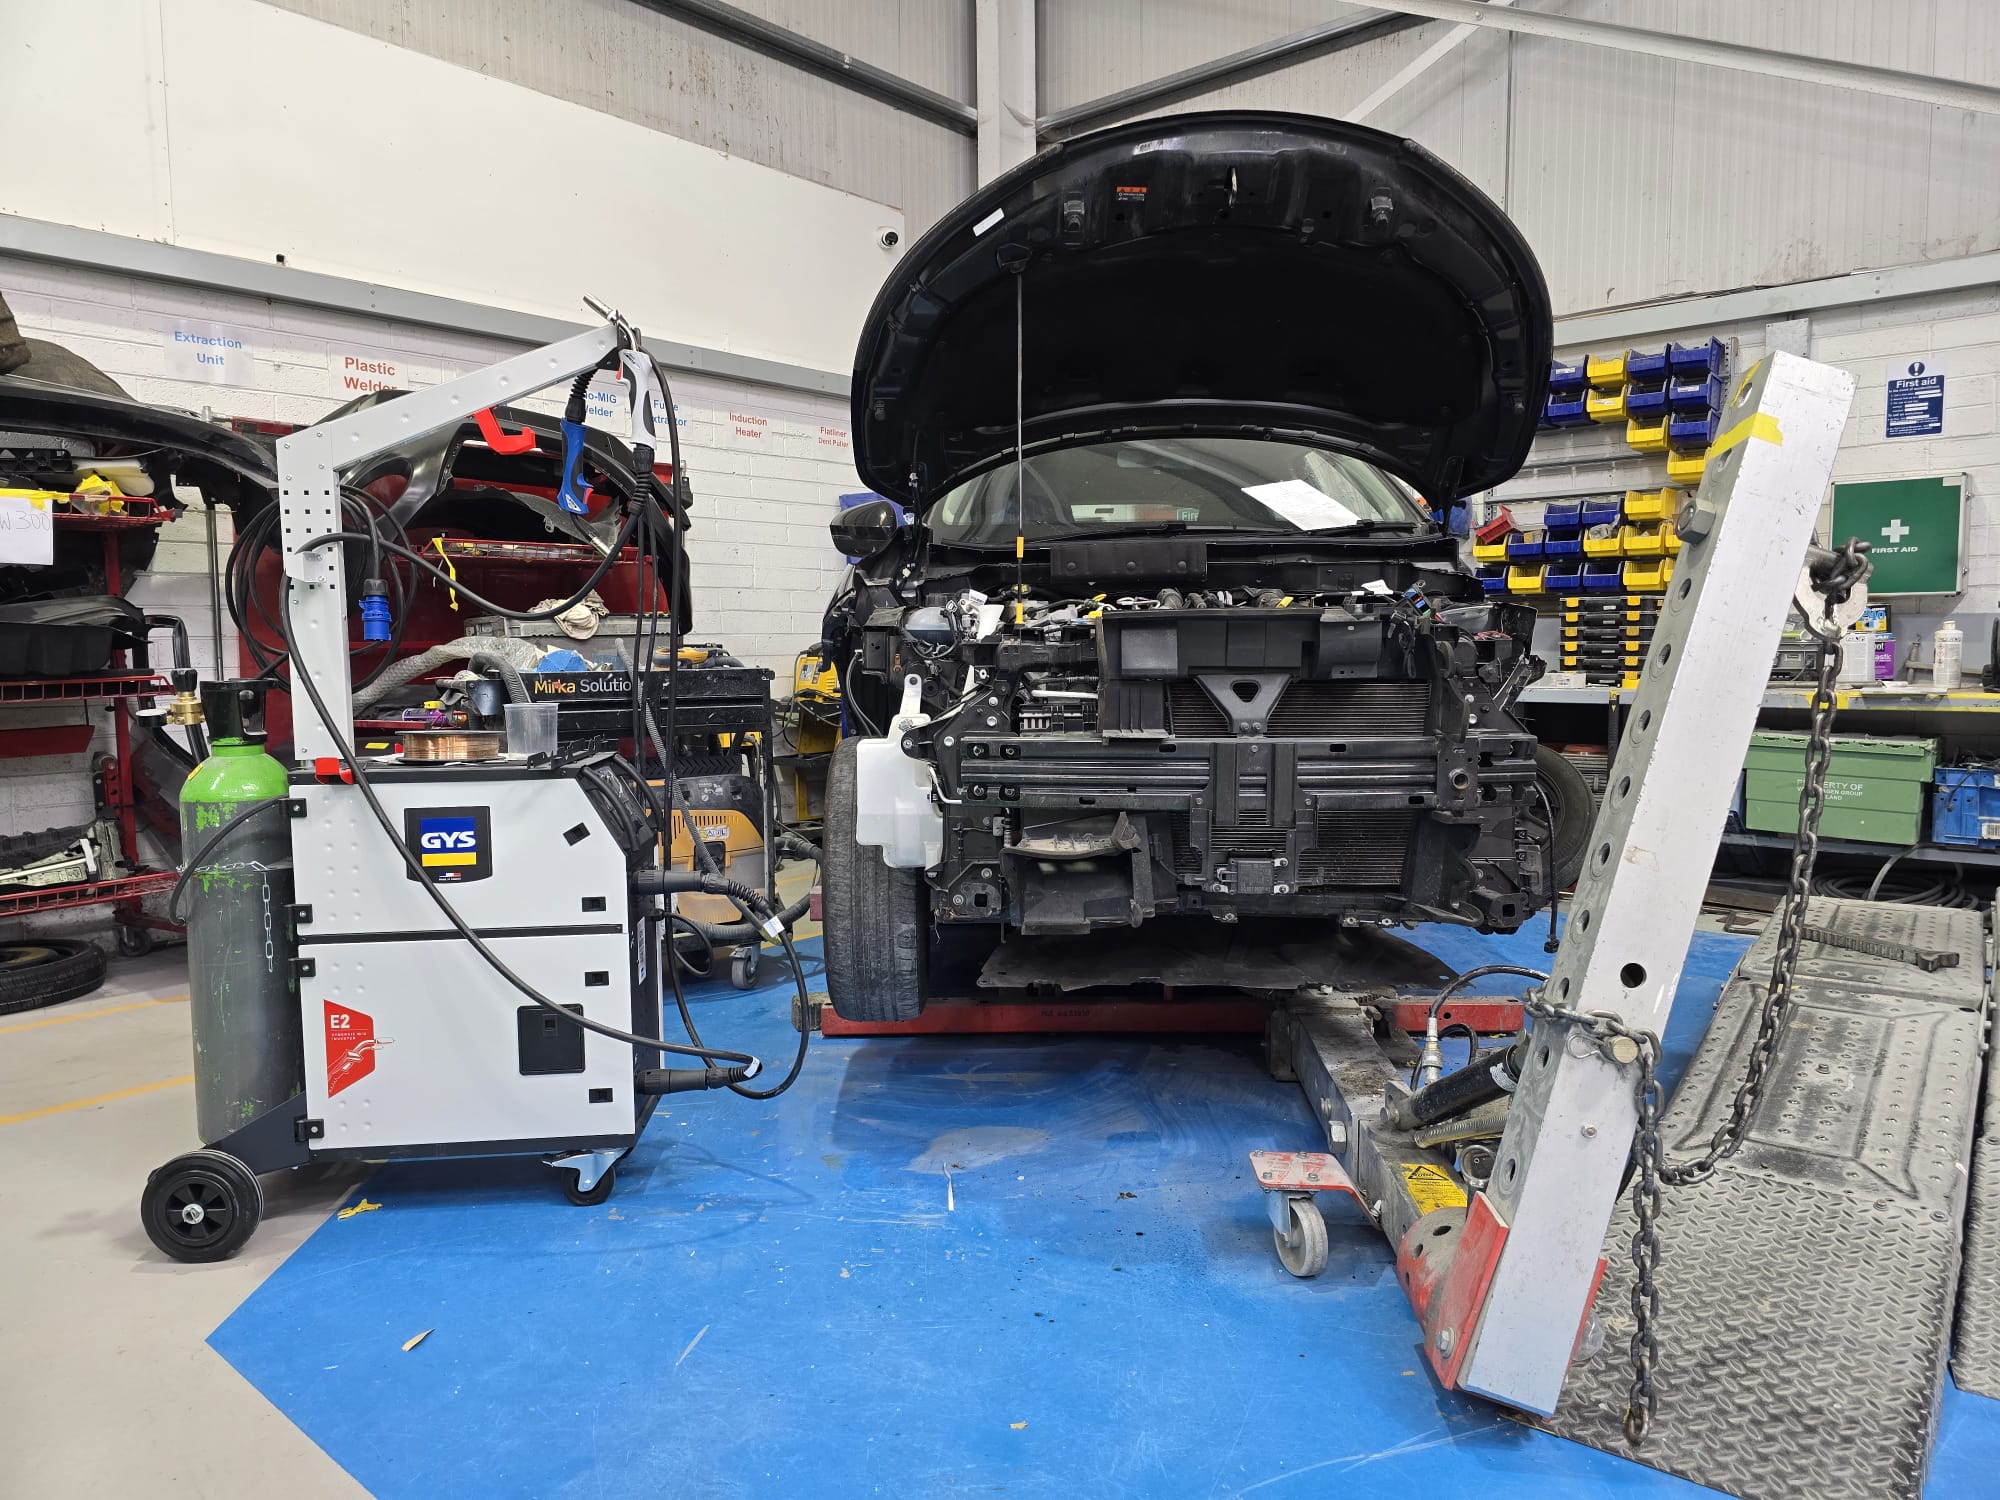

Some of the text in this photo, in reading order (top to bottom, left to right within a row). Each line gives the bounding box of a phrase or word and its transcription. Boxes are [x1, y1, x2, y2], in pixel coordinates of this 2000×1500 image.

[174, 331, 242, 349] Extraction
[196, 352, 225, 365] Unit
[344, 356, 396, 376] Plastic
[1896, 376, 1937, 388] First aid
[653, 400, 679, 411] Fue
[729, 412, 768, 426] Induction
[735, 426, 763, 438] Heater
[820, 426, 848, 438] Flatliner
[15, 510, 51, 531] 300
[534, 678, 632, 694] Mirka Solutio
[1849, 783, 1864, 791] OF
[420, 830, 477, 849] GYS
[330, 1014, 350, 1029] E2
